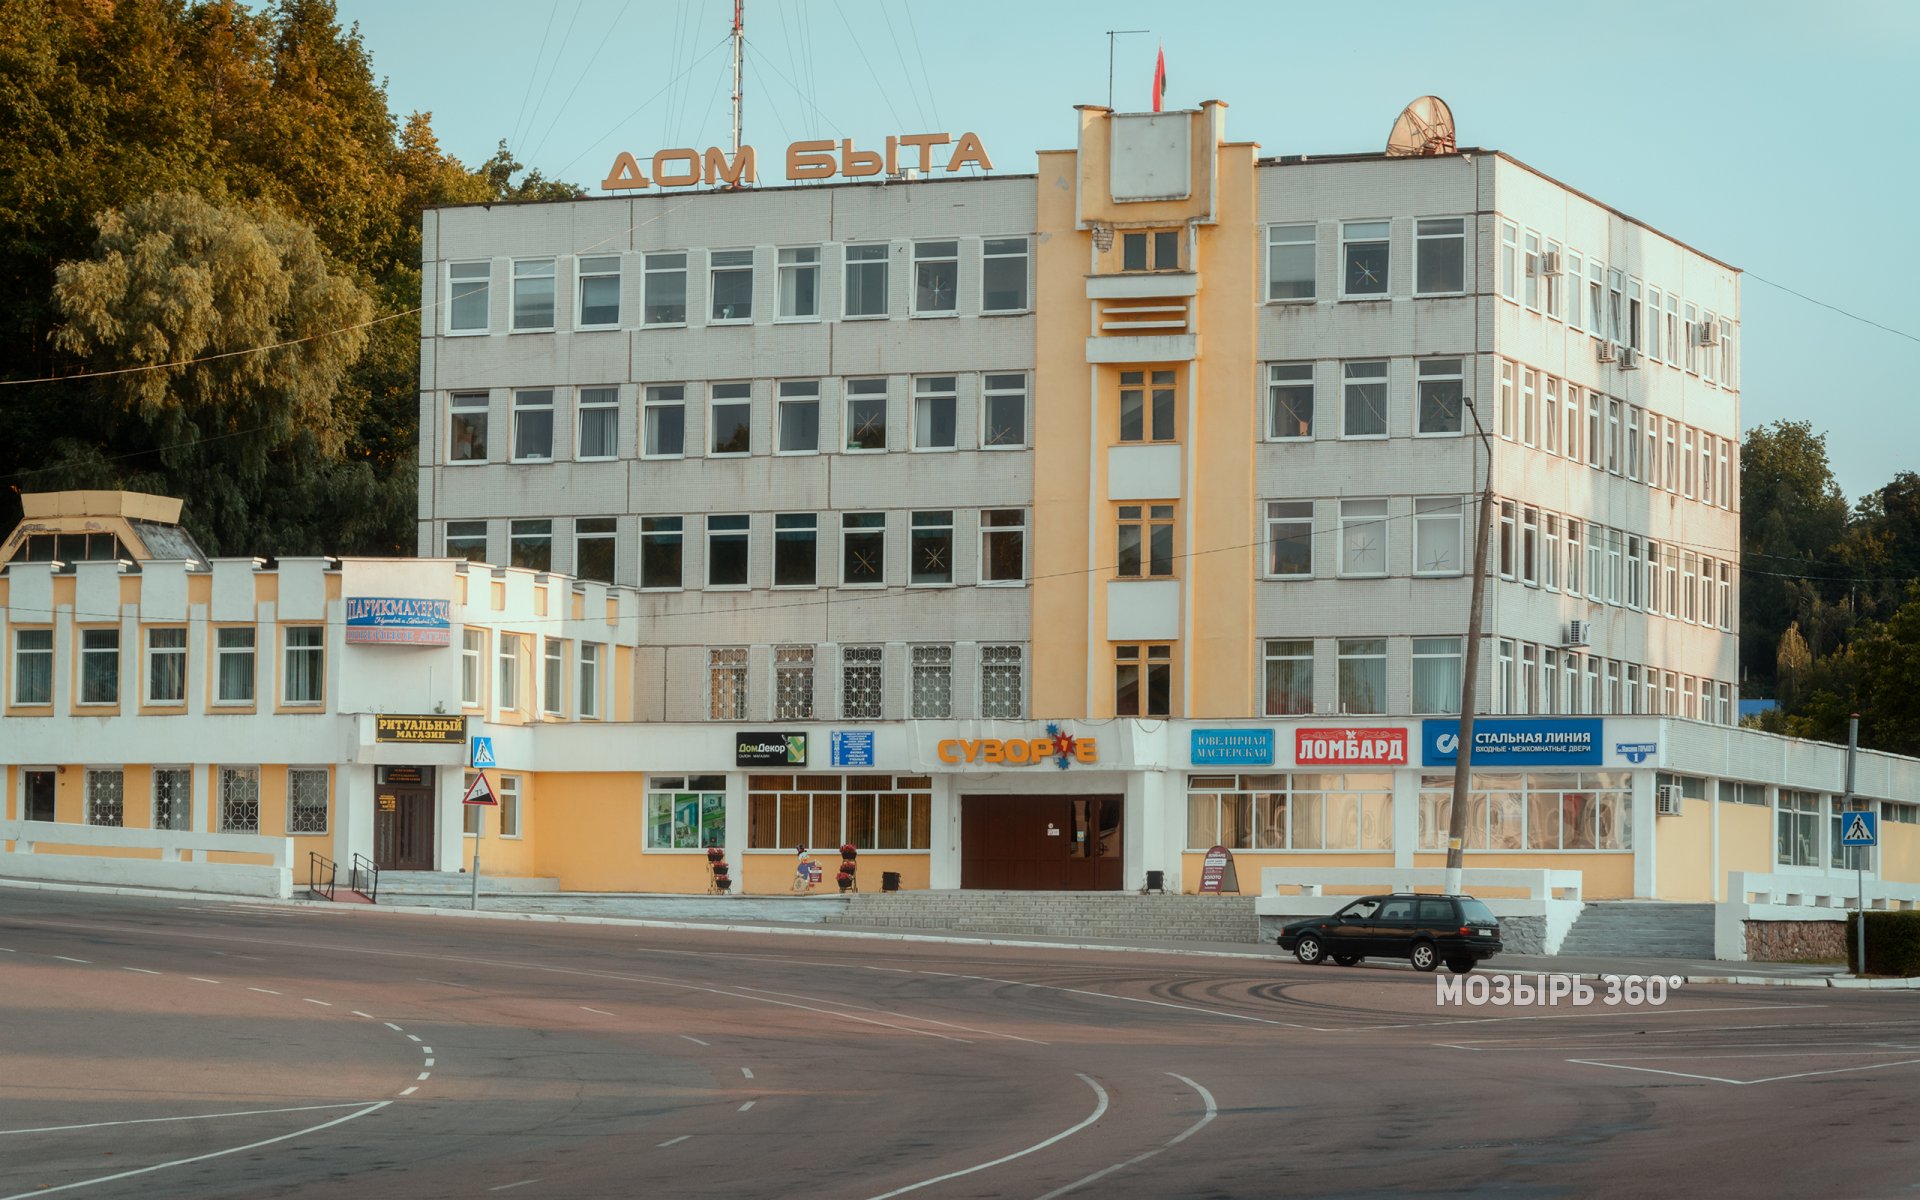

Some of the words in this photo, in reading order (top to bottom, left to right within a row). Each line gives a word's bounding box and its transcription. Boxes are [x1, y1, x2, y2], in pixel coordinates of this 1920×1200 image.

[601, 145, 756, 190] ДОМ
[786, 132, 993, 180] БЫТА
[379, 719, 463, 731] РИТУАЛЬНЫЙ
[396, 730, 446, 739] МАГАЗИН
[1475, 733, 1542, 744] СТАЛЬНАЯ
[1545, 732, 1591, 743] ЛИНИЯ
[1198, 736, 1266, 746] ЮВЕЛИРНАЯ
[738, 743, 786, 754] ДомДекор
[1197, 748, 1267, 758] МАСТЕРСКАЯ
[1299, 739, 1404, 760] ЛОМБАРД
[1475, 745, 1507, 753] ВХОДНЫЕ
[1512, 745, 1567, 753] МЕЖКОМНАТНЫЕ
[1568, 745, 1591, 753] ДВЕРИ
